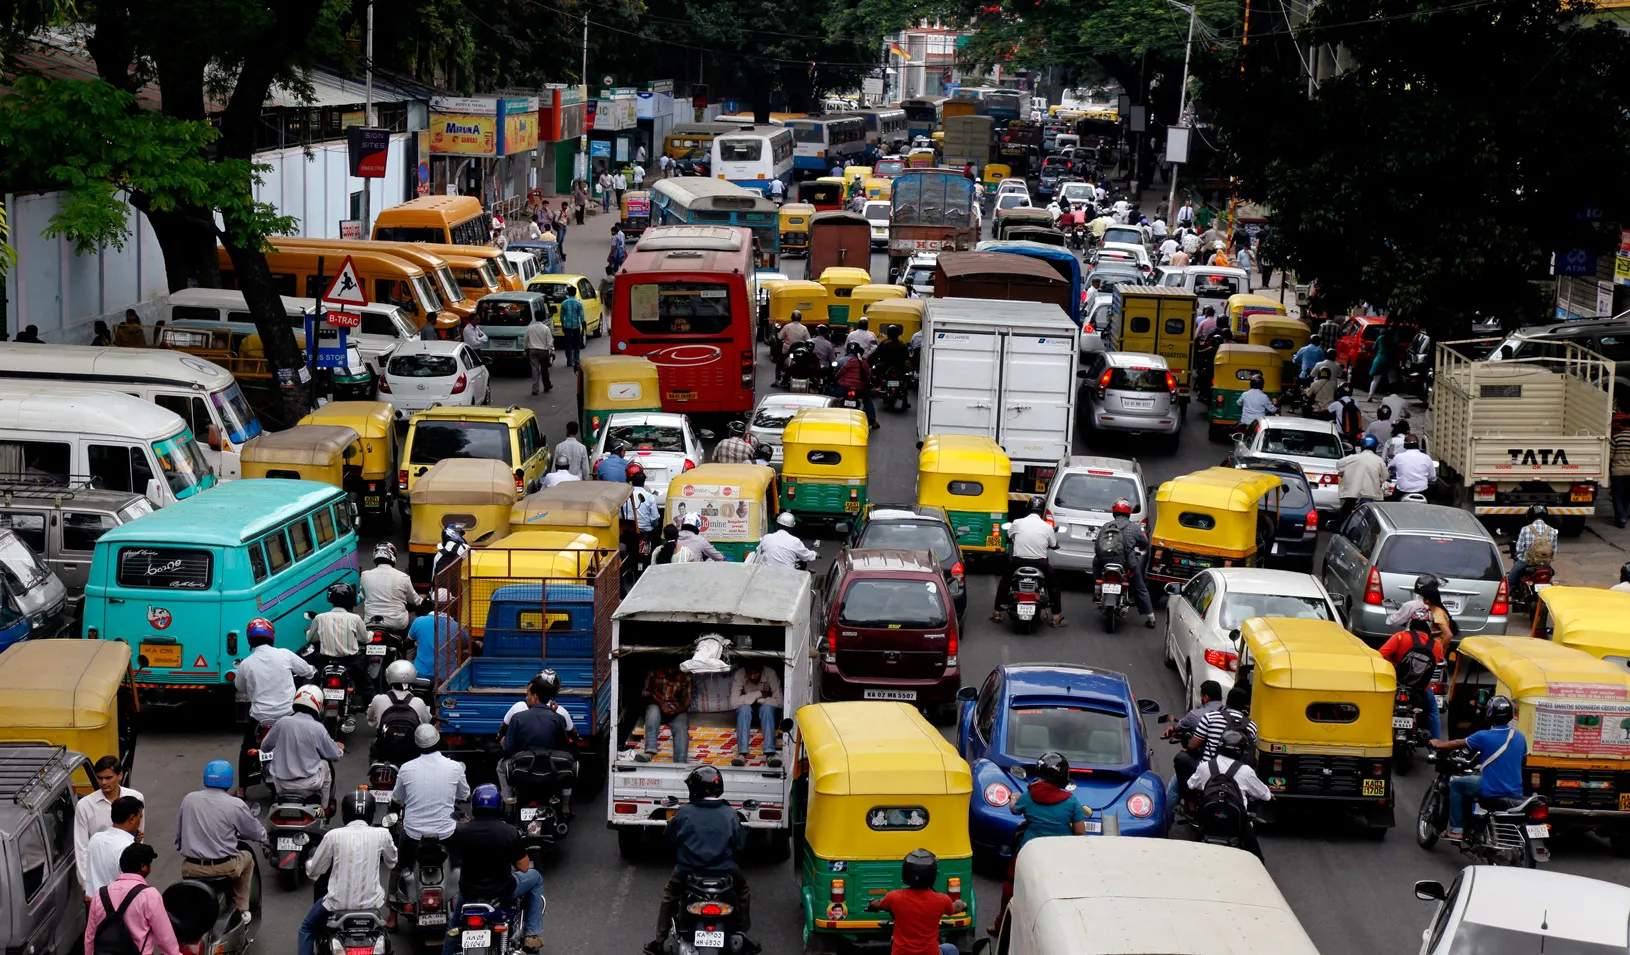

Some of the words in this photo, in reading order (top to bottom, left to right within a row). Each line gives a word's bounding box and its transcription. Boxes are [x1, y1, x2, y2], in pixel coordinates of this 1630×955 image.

[329, 314, 359, 326] B-TRAC
[1507, 449, 1569, 465] TATA
[1537, 700, 1553, 709] SHREE
